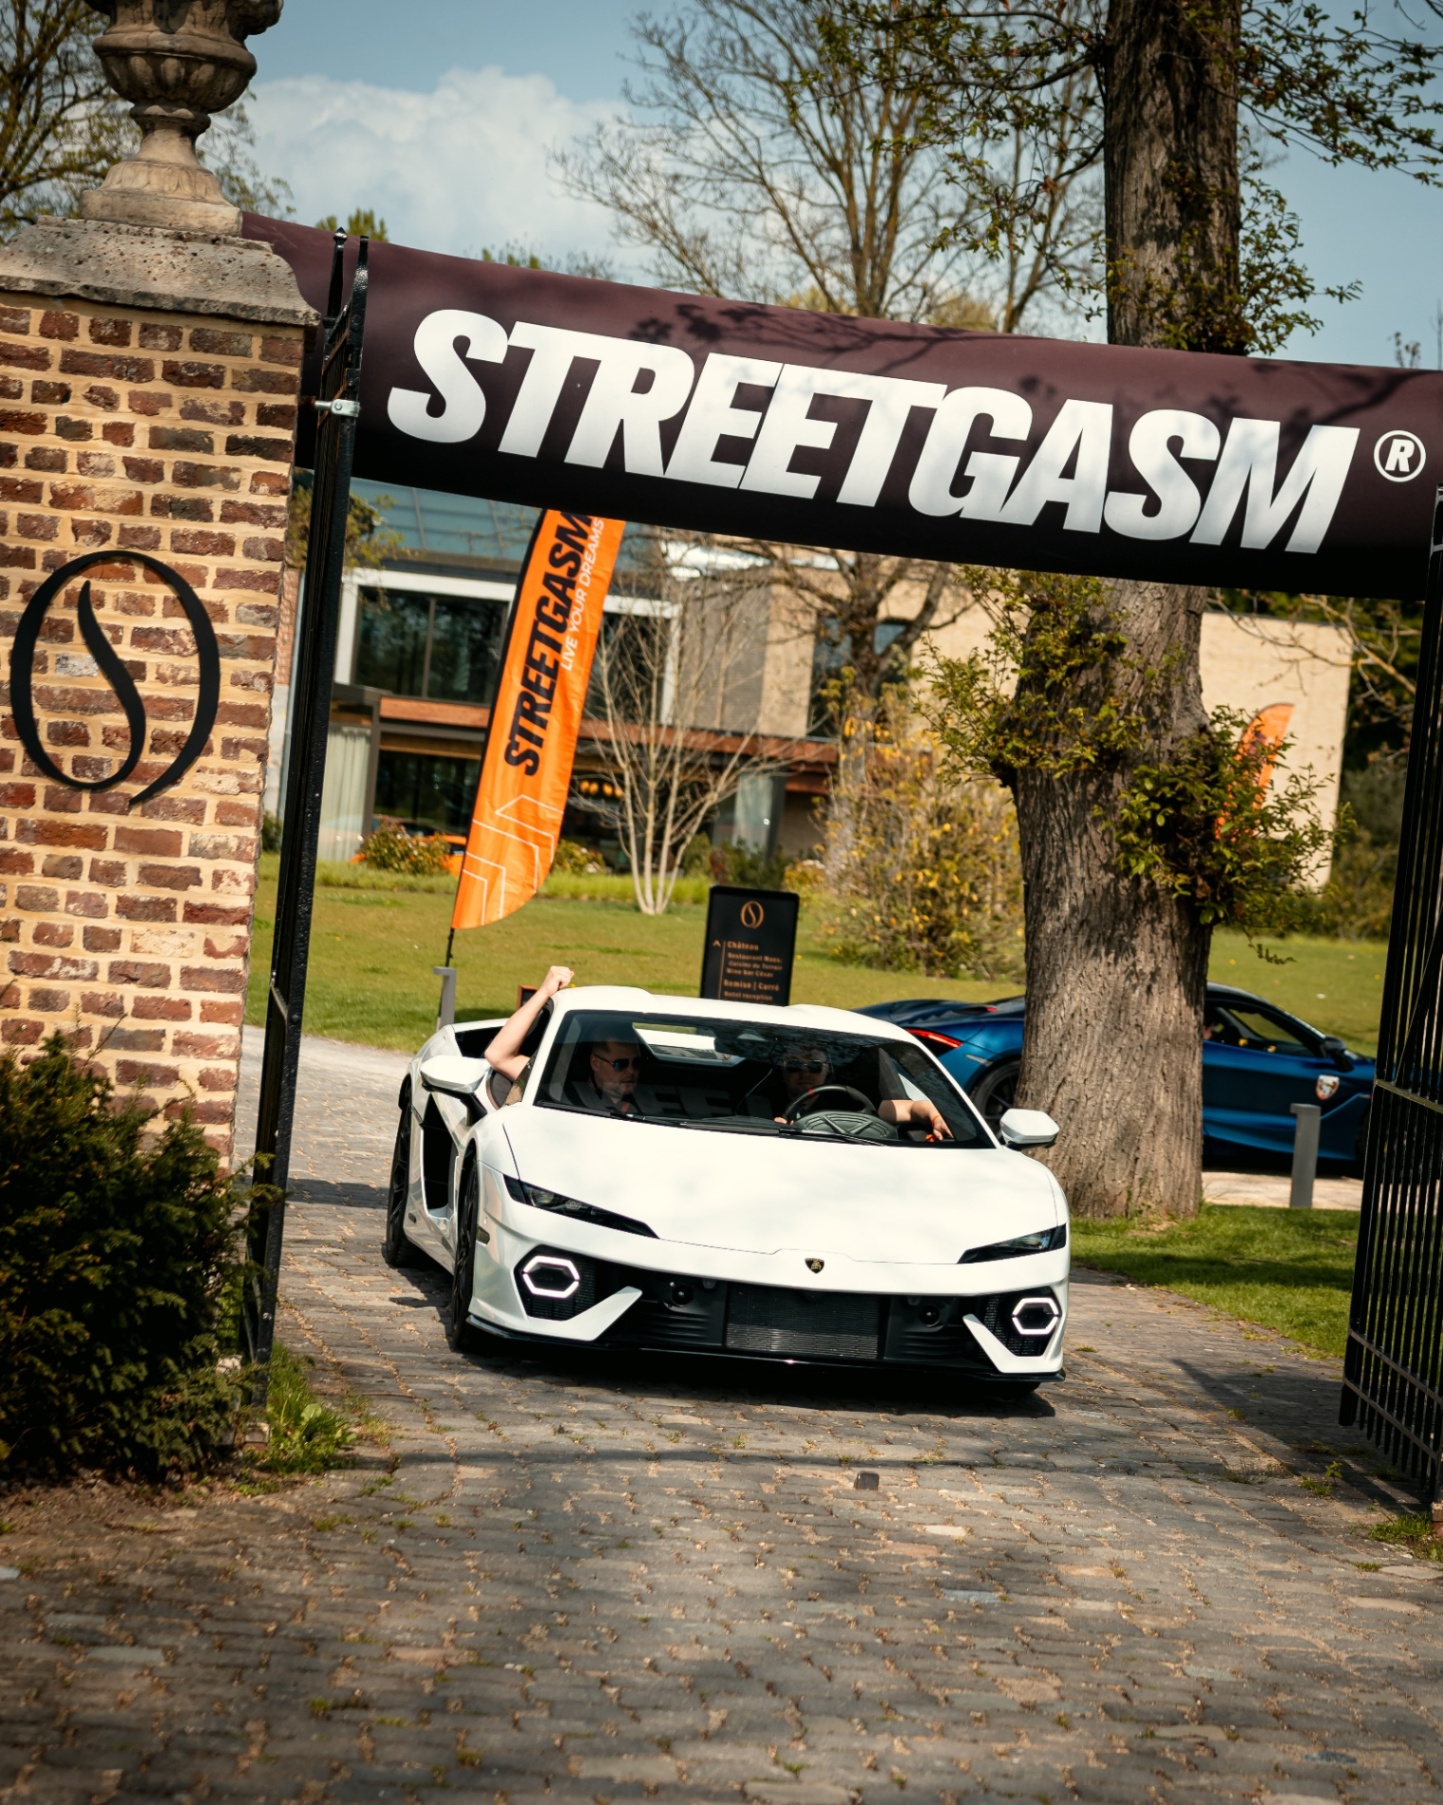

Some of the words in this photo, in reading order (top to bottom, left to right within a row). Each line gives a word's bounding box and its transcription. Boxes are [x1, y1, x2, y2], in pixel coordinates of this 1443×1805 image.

[387, 308, 1360, 555] STREETGASM
[579, 517, 605, 588] DREAMS
[568, 588, 588, 633] YOUR
[504, 511, 594, 776] STREETGASM
[560, 635, 578, 672] LIVE
[727, 940, 759, 951] Château
[728, 952, 763, 961] Restaurant
